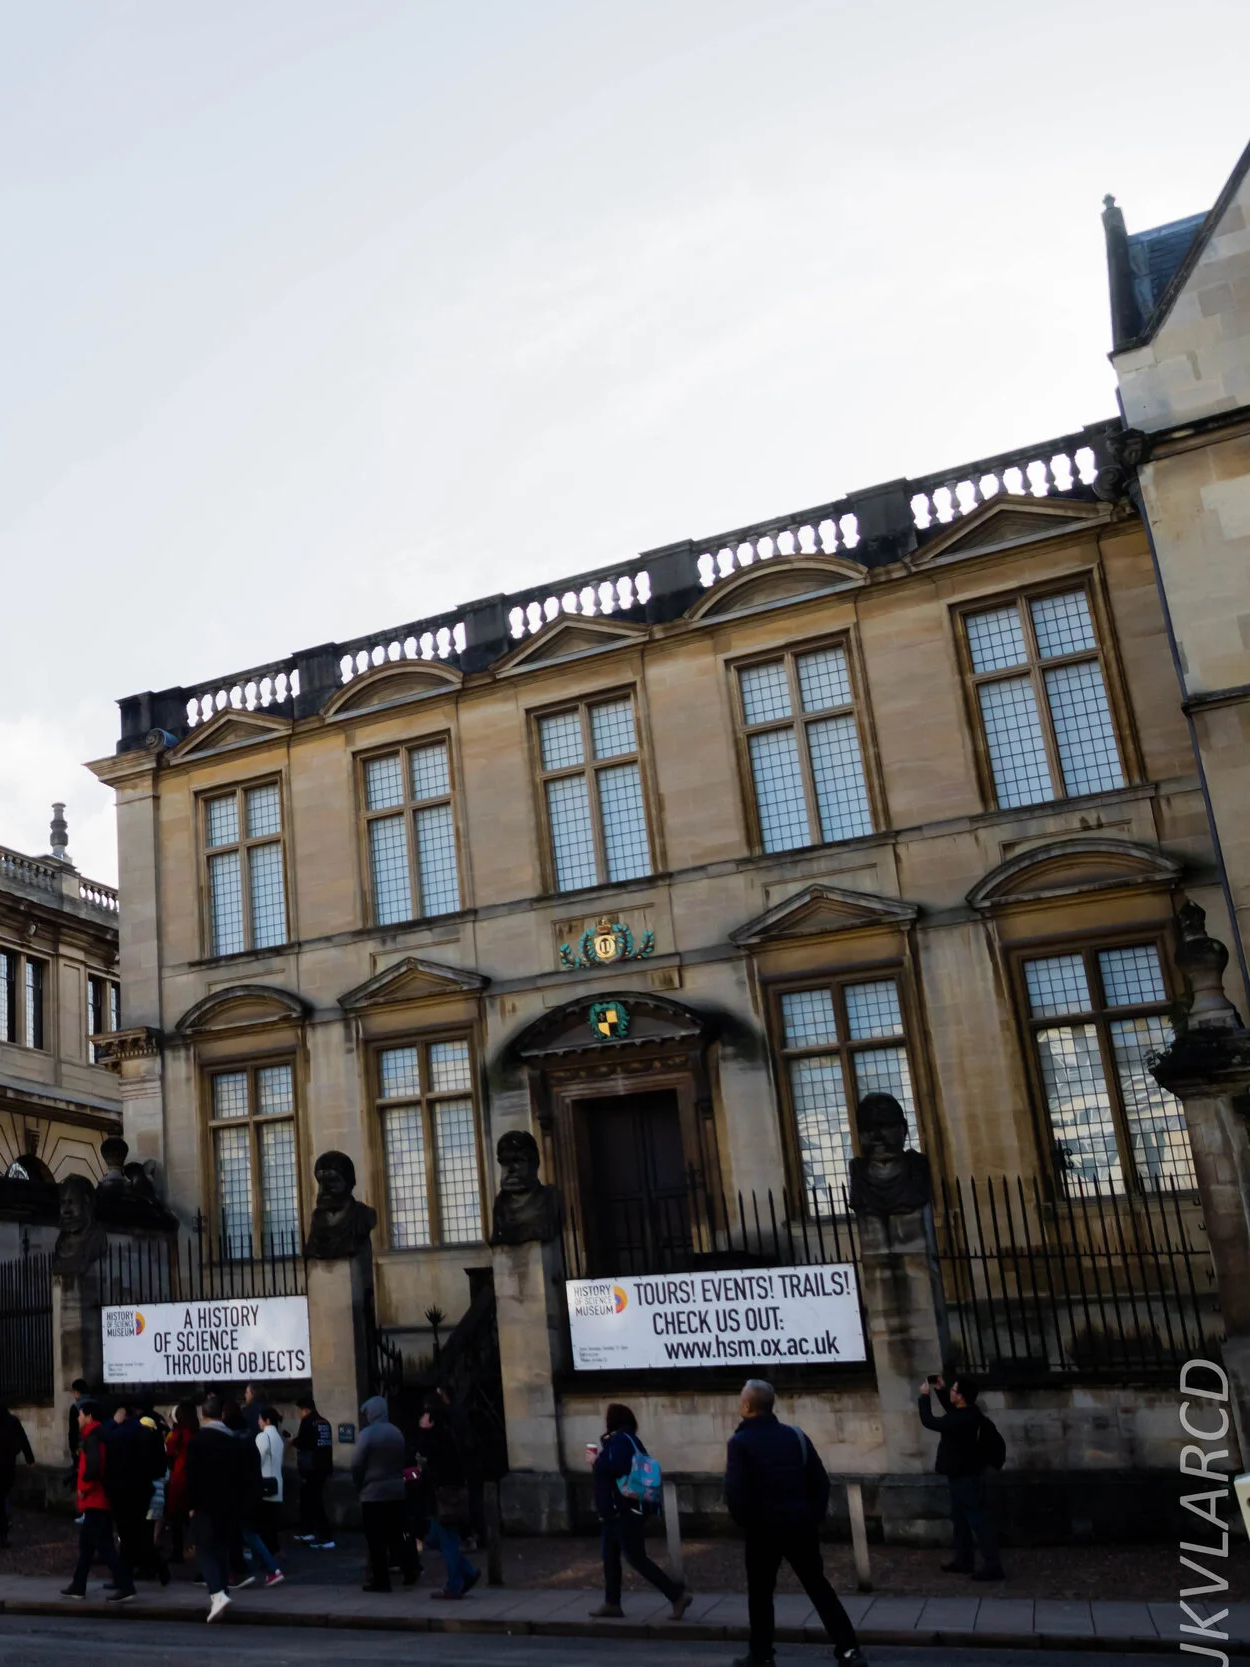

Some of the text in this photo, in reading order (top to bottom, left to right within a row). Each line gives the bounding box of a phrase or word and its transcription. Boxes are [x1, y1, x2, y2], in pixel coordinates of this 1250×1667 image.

[574, 1285, 611, 1297] HISTORY
[634, 1271, 850, 1306] TOURS! EVENTS! TRAILS!
[106, 1310, 134, 1321] HISTORY
[183, 1304, 259, 1329] A HISTORY
[575, 1305, 614, 1317] MUSEUM
[652, 1306, 784, 1335] CHECK US OUT:
[107, 1327, 135, 1337] MUSEUM
[154, 1329, 238, 1353] OF SCIENCE
[664, 1330, 840, 1360] www.hsm.ox.ac.uk
[164, 1350, 306, 1375] THROUGH OBJECTS
